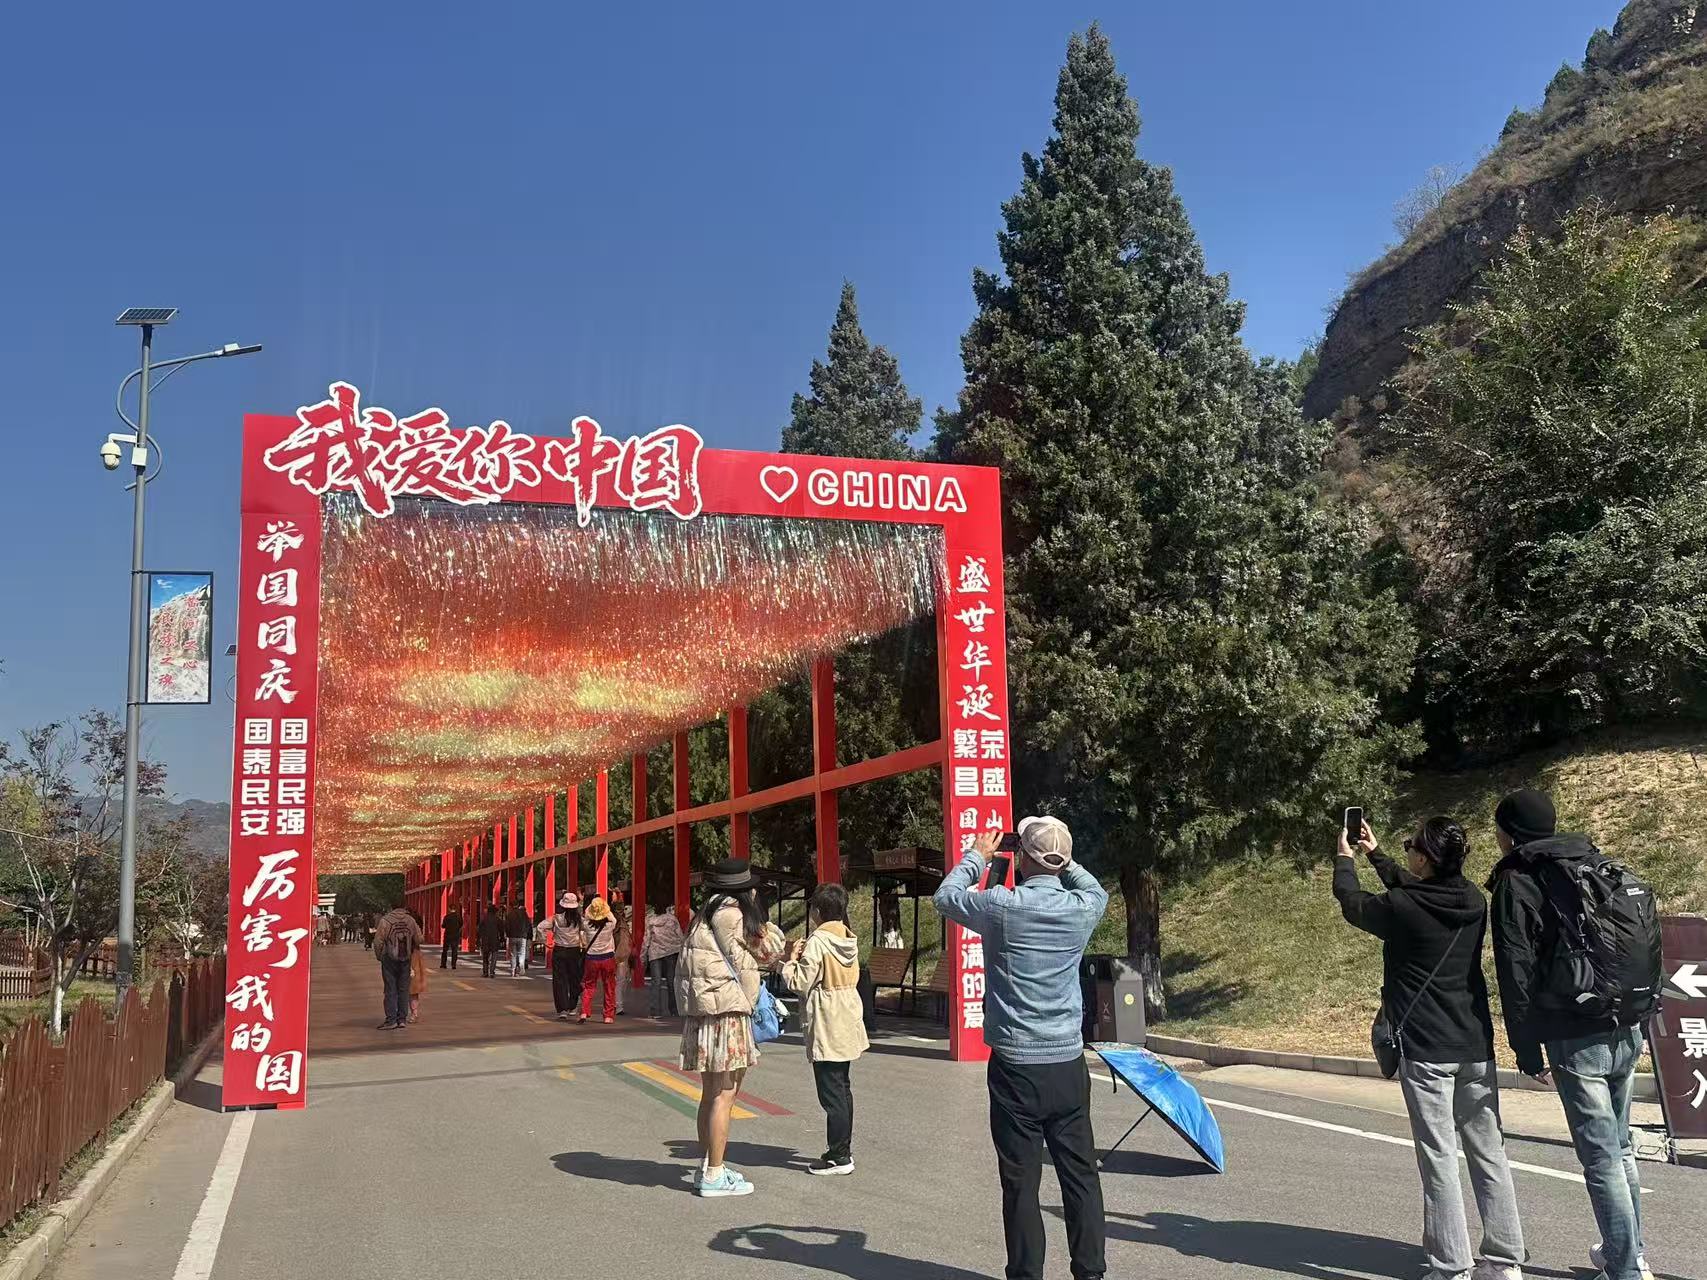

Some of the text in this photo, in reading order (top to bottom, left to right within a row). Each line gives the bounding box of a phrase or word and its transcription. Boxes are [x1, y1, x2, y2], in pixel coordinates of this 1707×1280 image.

[264, 381, 704, 527] 我爱你中国
[807, 468, 967, 513] CHINA
[254, 520, 305, 703] 举国同庆
[954, 555, 1001, 721] 盛世华诞
[240, 718, 273, 836] 国泰民安
[276, 718, 308, 835] 国富民强
[226, 849, 309, 1094] 厉害了我的国
